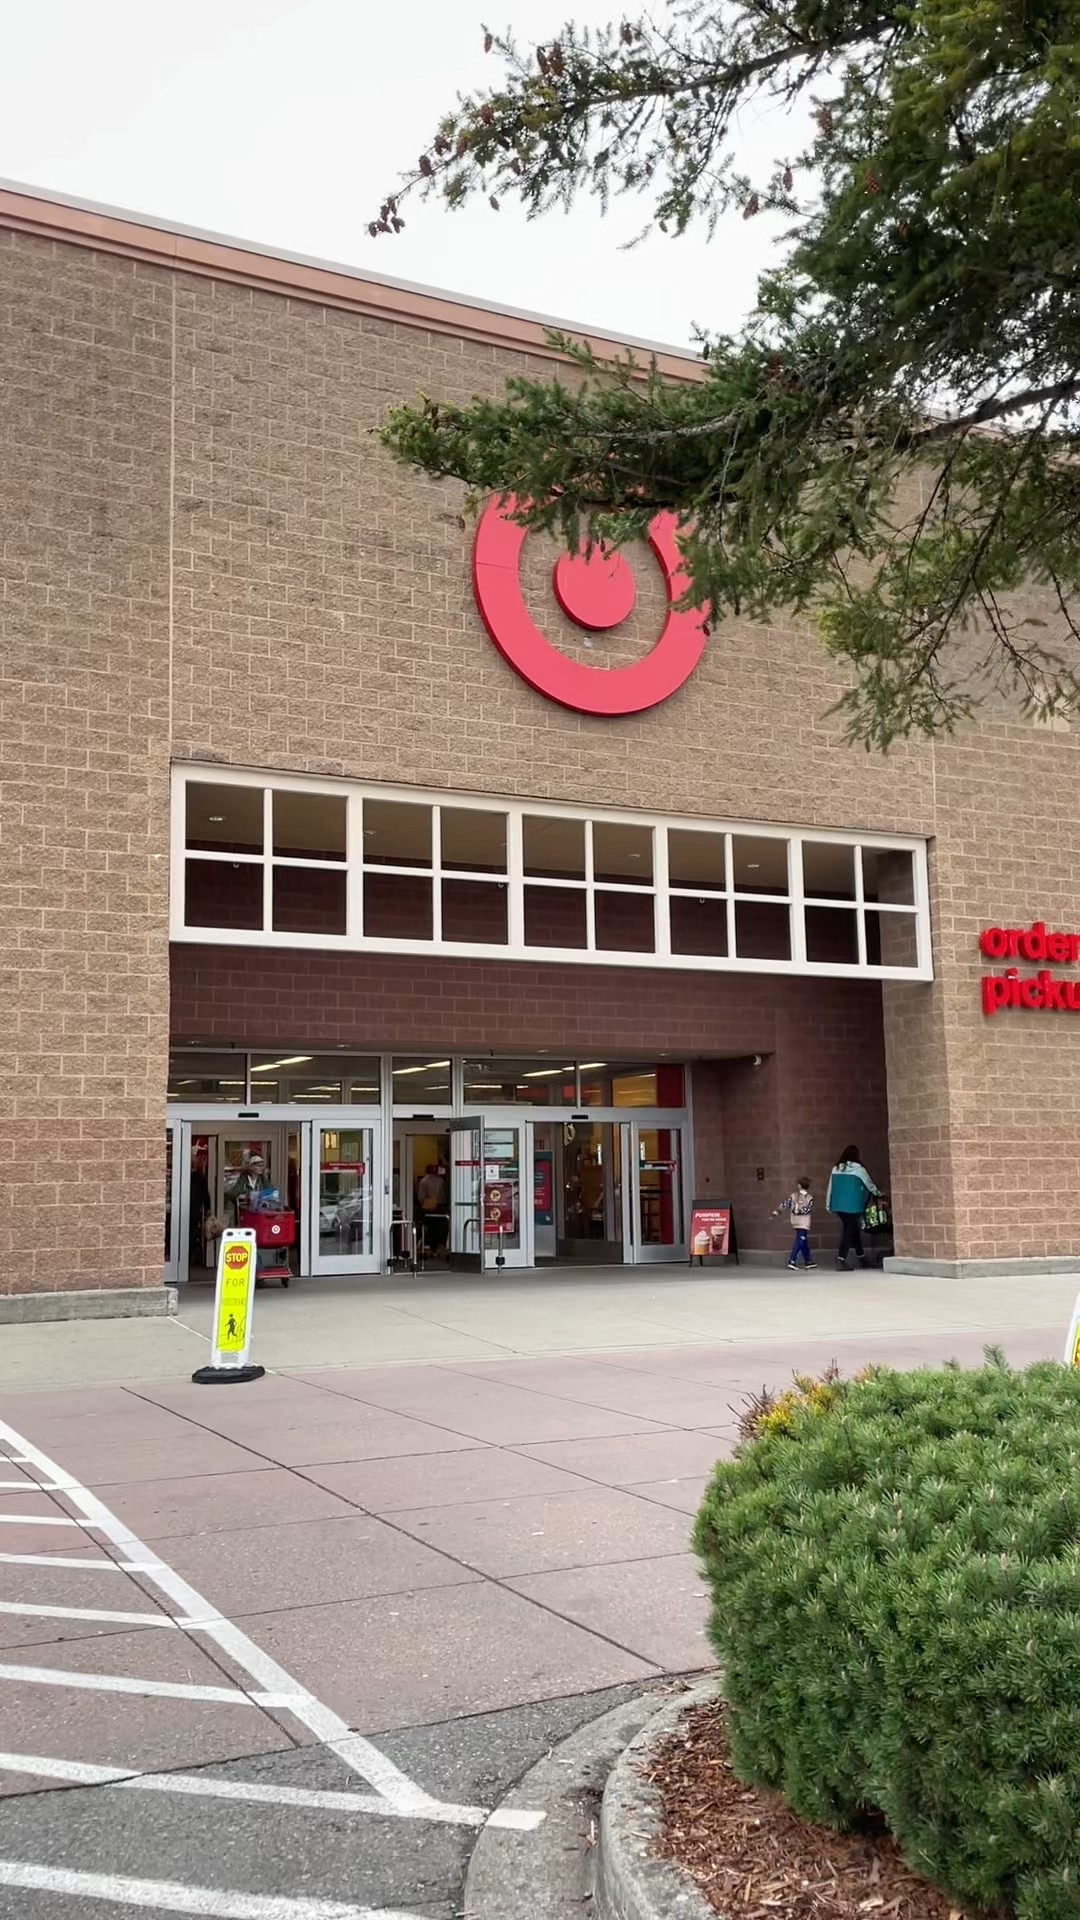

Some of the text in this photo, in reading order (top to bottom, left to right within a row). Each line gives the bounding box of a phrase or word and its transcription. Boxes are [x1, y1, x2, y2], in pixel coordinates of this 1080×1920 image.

[979, 921, 1080, 962] order
[226, 1252, 248, 1263] STOP
[226, 1278, 245, 1287] FOR
